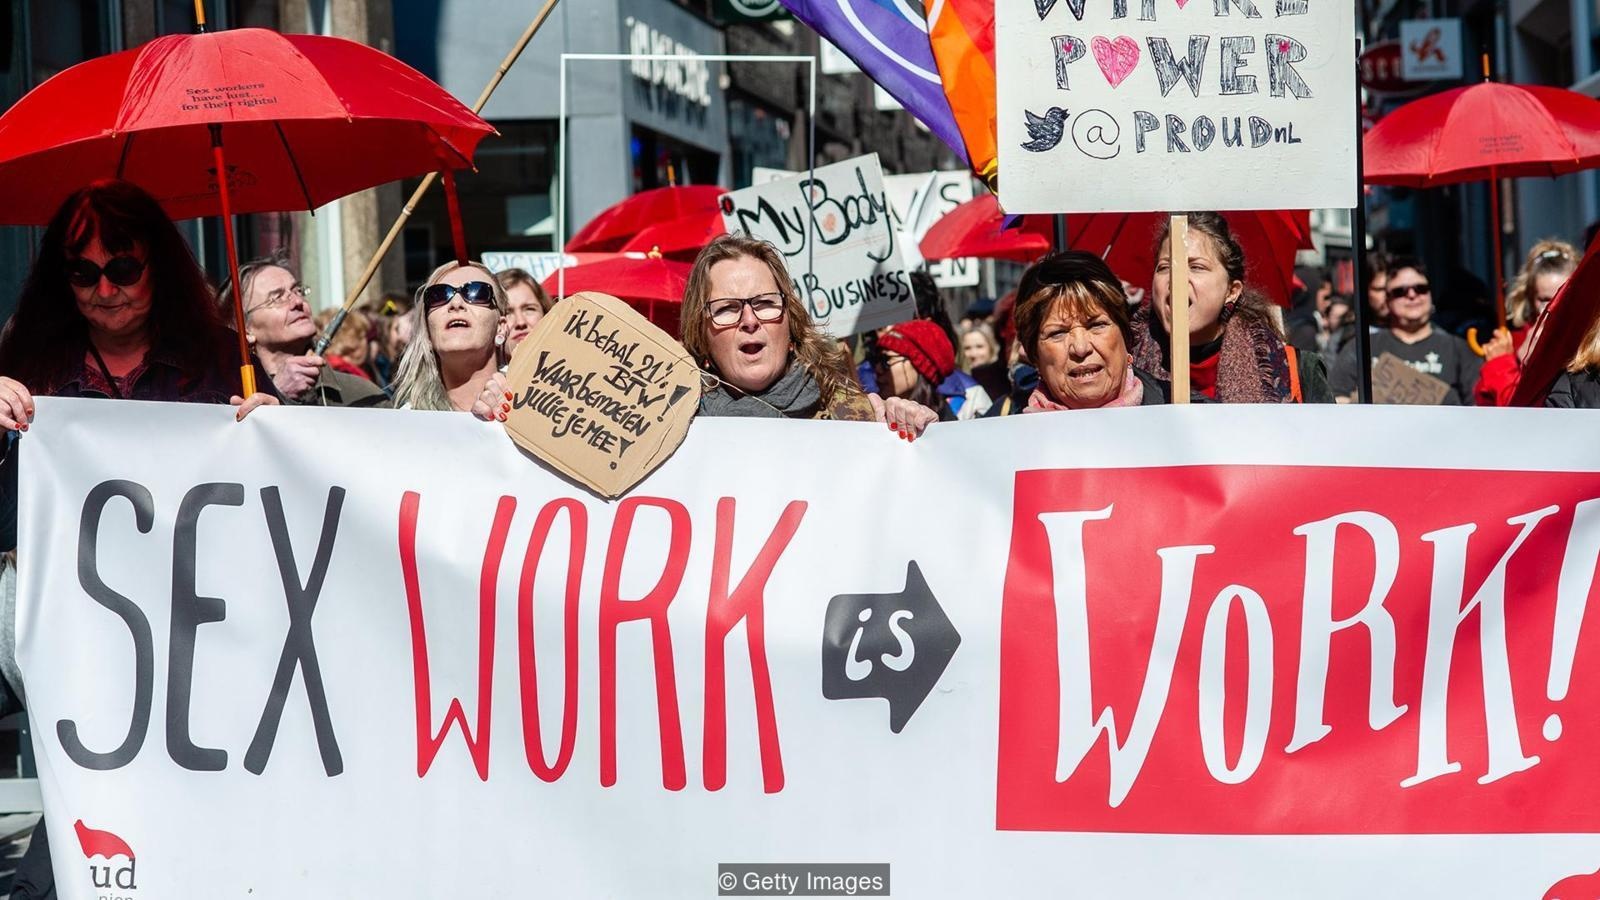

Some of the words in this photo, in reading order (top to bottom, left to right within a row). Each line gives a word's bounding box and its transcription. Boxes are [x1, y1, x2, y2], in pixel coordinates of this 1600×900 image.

[192, 94, 221, 102] have
[214, 83, 265, 93] workers
[182, 103, 199, 111] for
[204, 100, 232, 109] their
[237, 96, 278, 107] rights!
[737, 195, 806, 256] My
[799, 166, 894, 263] Body
[563, 309, 590, 338] ik
[57, 479, 346, 777] SEX
[398, 491, 808, 793] WORK
[845, 607, 915, 681] is
[90, 858, 137, 890] ud
